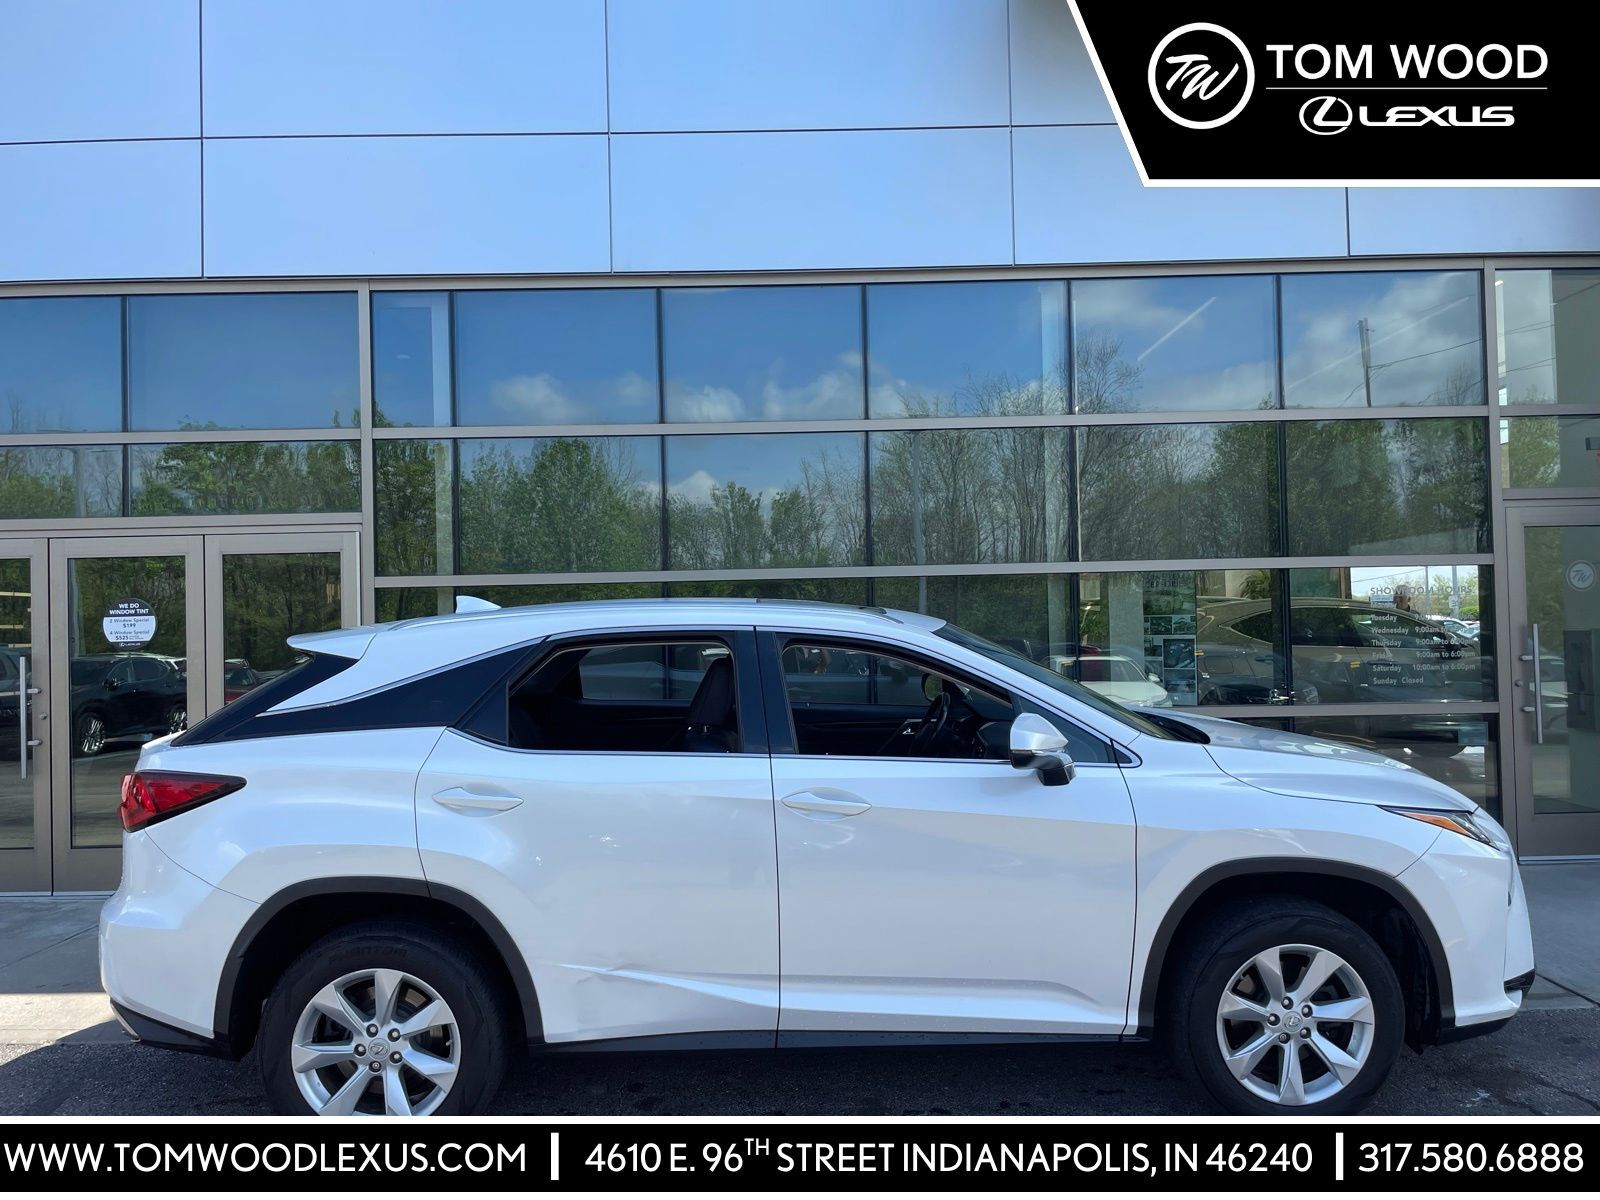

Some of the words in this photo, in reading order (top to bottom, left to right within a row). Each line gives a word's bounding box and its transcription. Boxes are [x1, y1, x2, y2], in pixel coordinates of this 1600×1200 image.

[1437, 585, 1473, 595] HOURS
[1370, 614, 1398, 623] Tuesday
[1371, 625, 1409, 635] Wednesday
[1371, 639, 1402, 647] Thursday
[1372, 664, 1402, 672] Saturday
[1450, 663, 1476, 671] 6:00pm
[1373, 677, 1398, 685] Sunday
[1401, 676, 1424, 684] Closed
